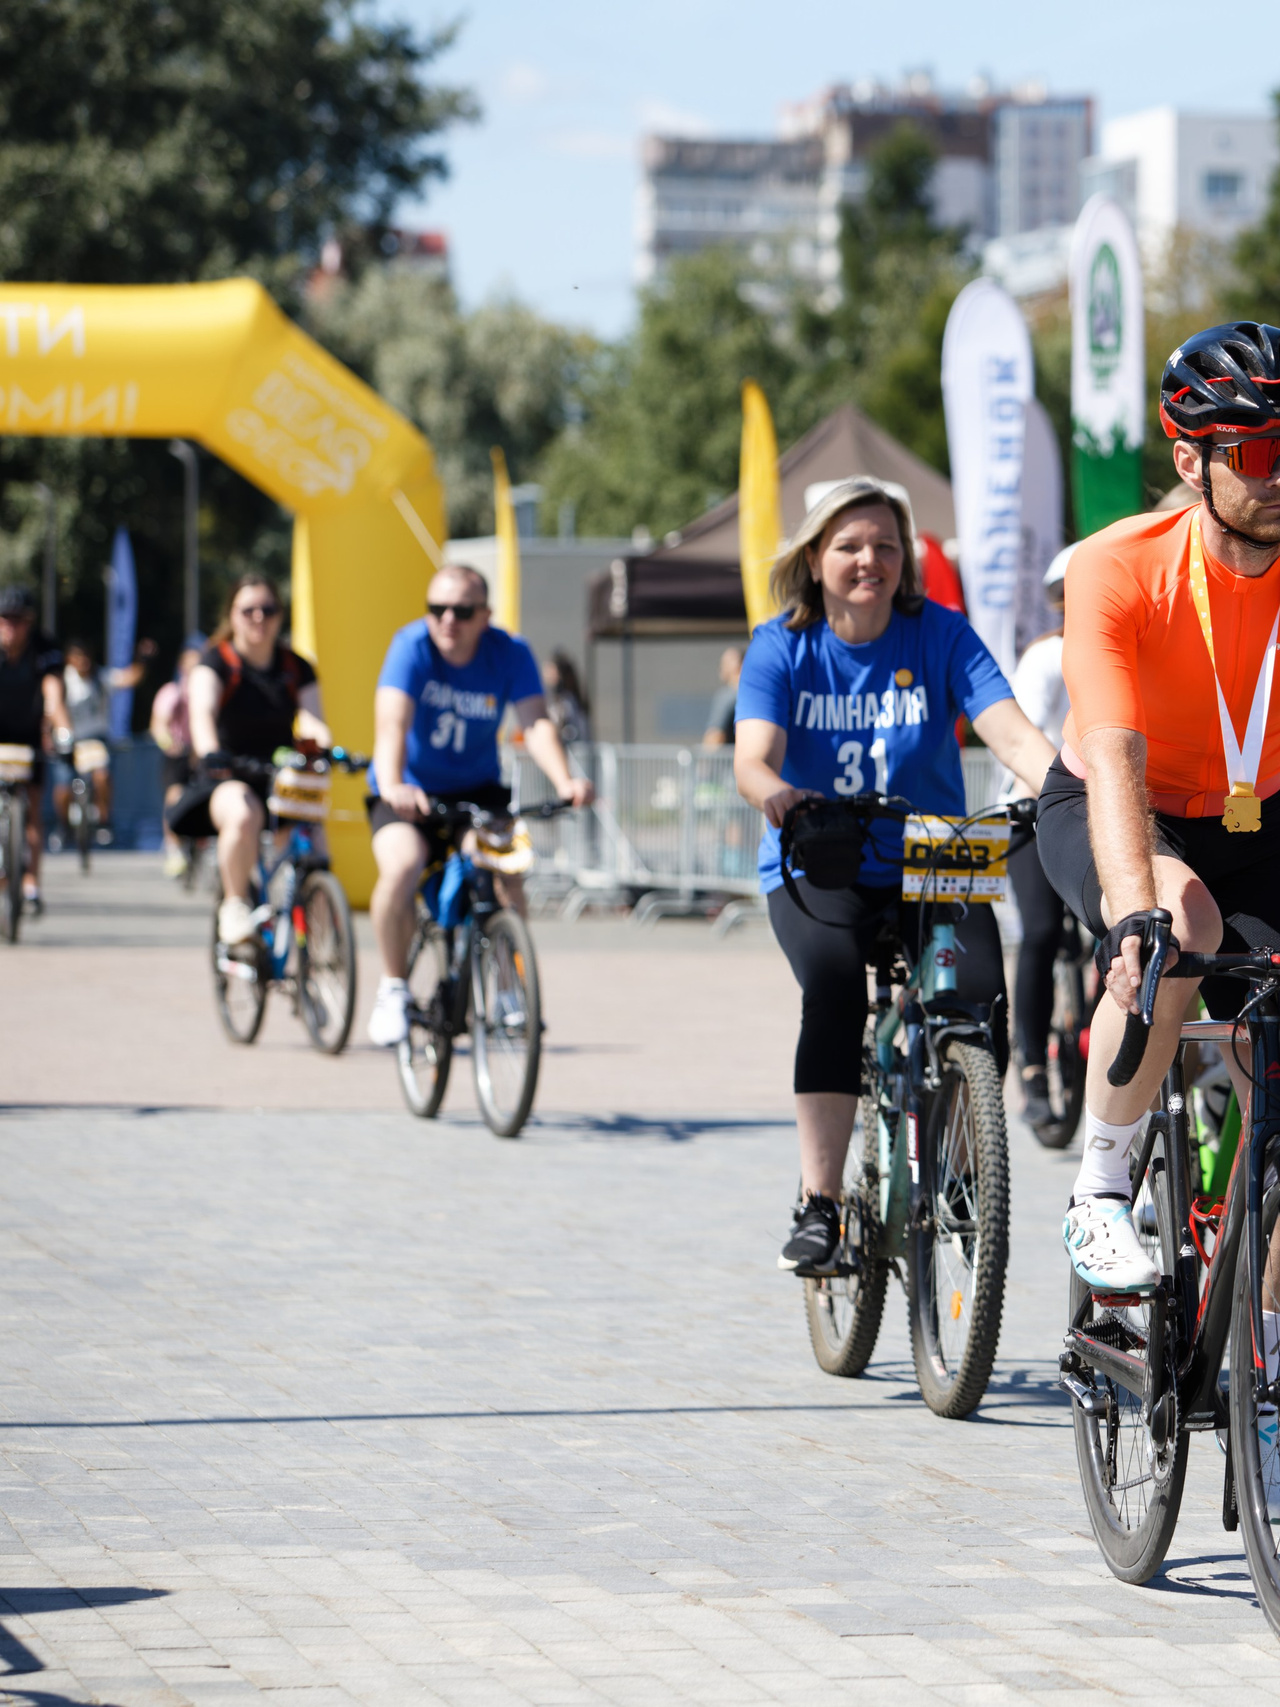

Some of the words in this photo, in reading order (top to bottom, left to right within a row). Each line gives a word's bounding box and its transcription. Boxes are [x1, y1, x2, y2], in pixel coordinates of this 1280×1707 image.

[795, 685, 929, 731] ГИМНАЗИЯ
[430, 710, 467, 753] 31
[833, 738, 889, 796] 31
